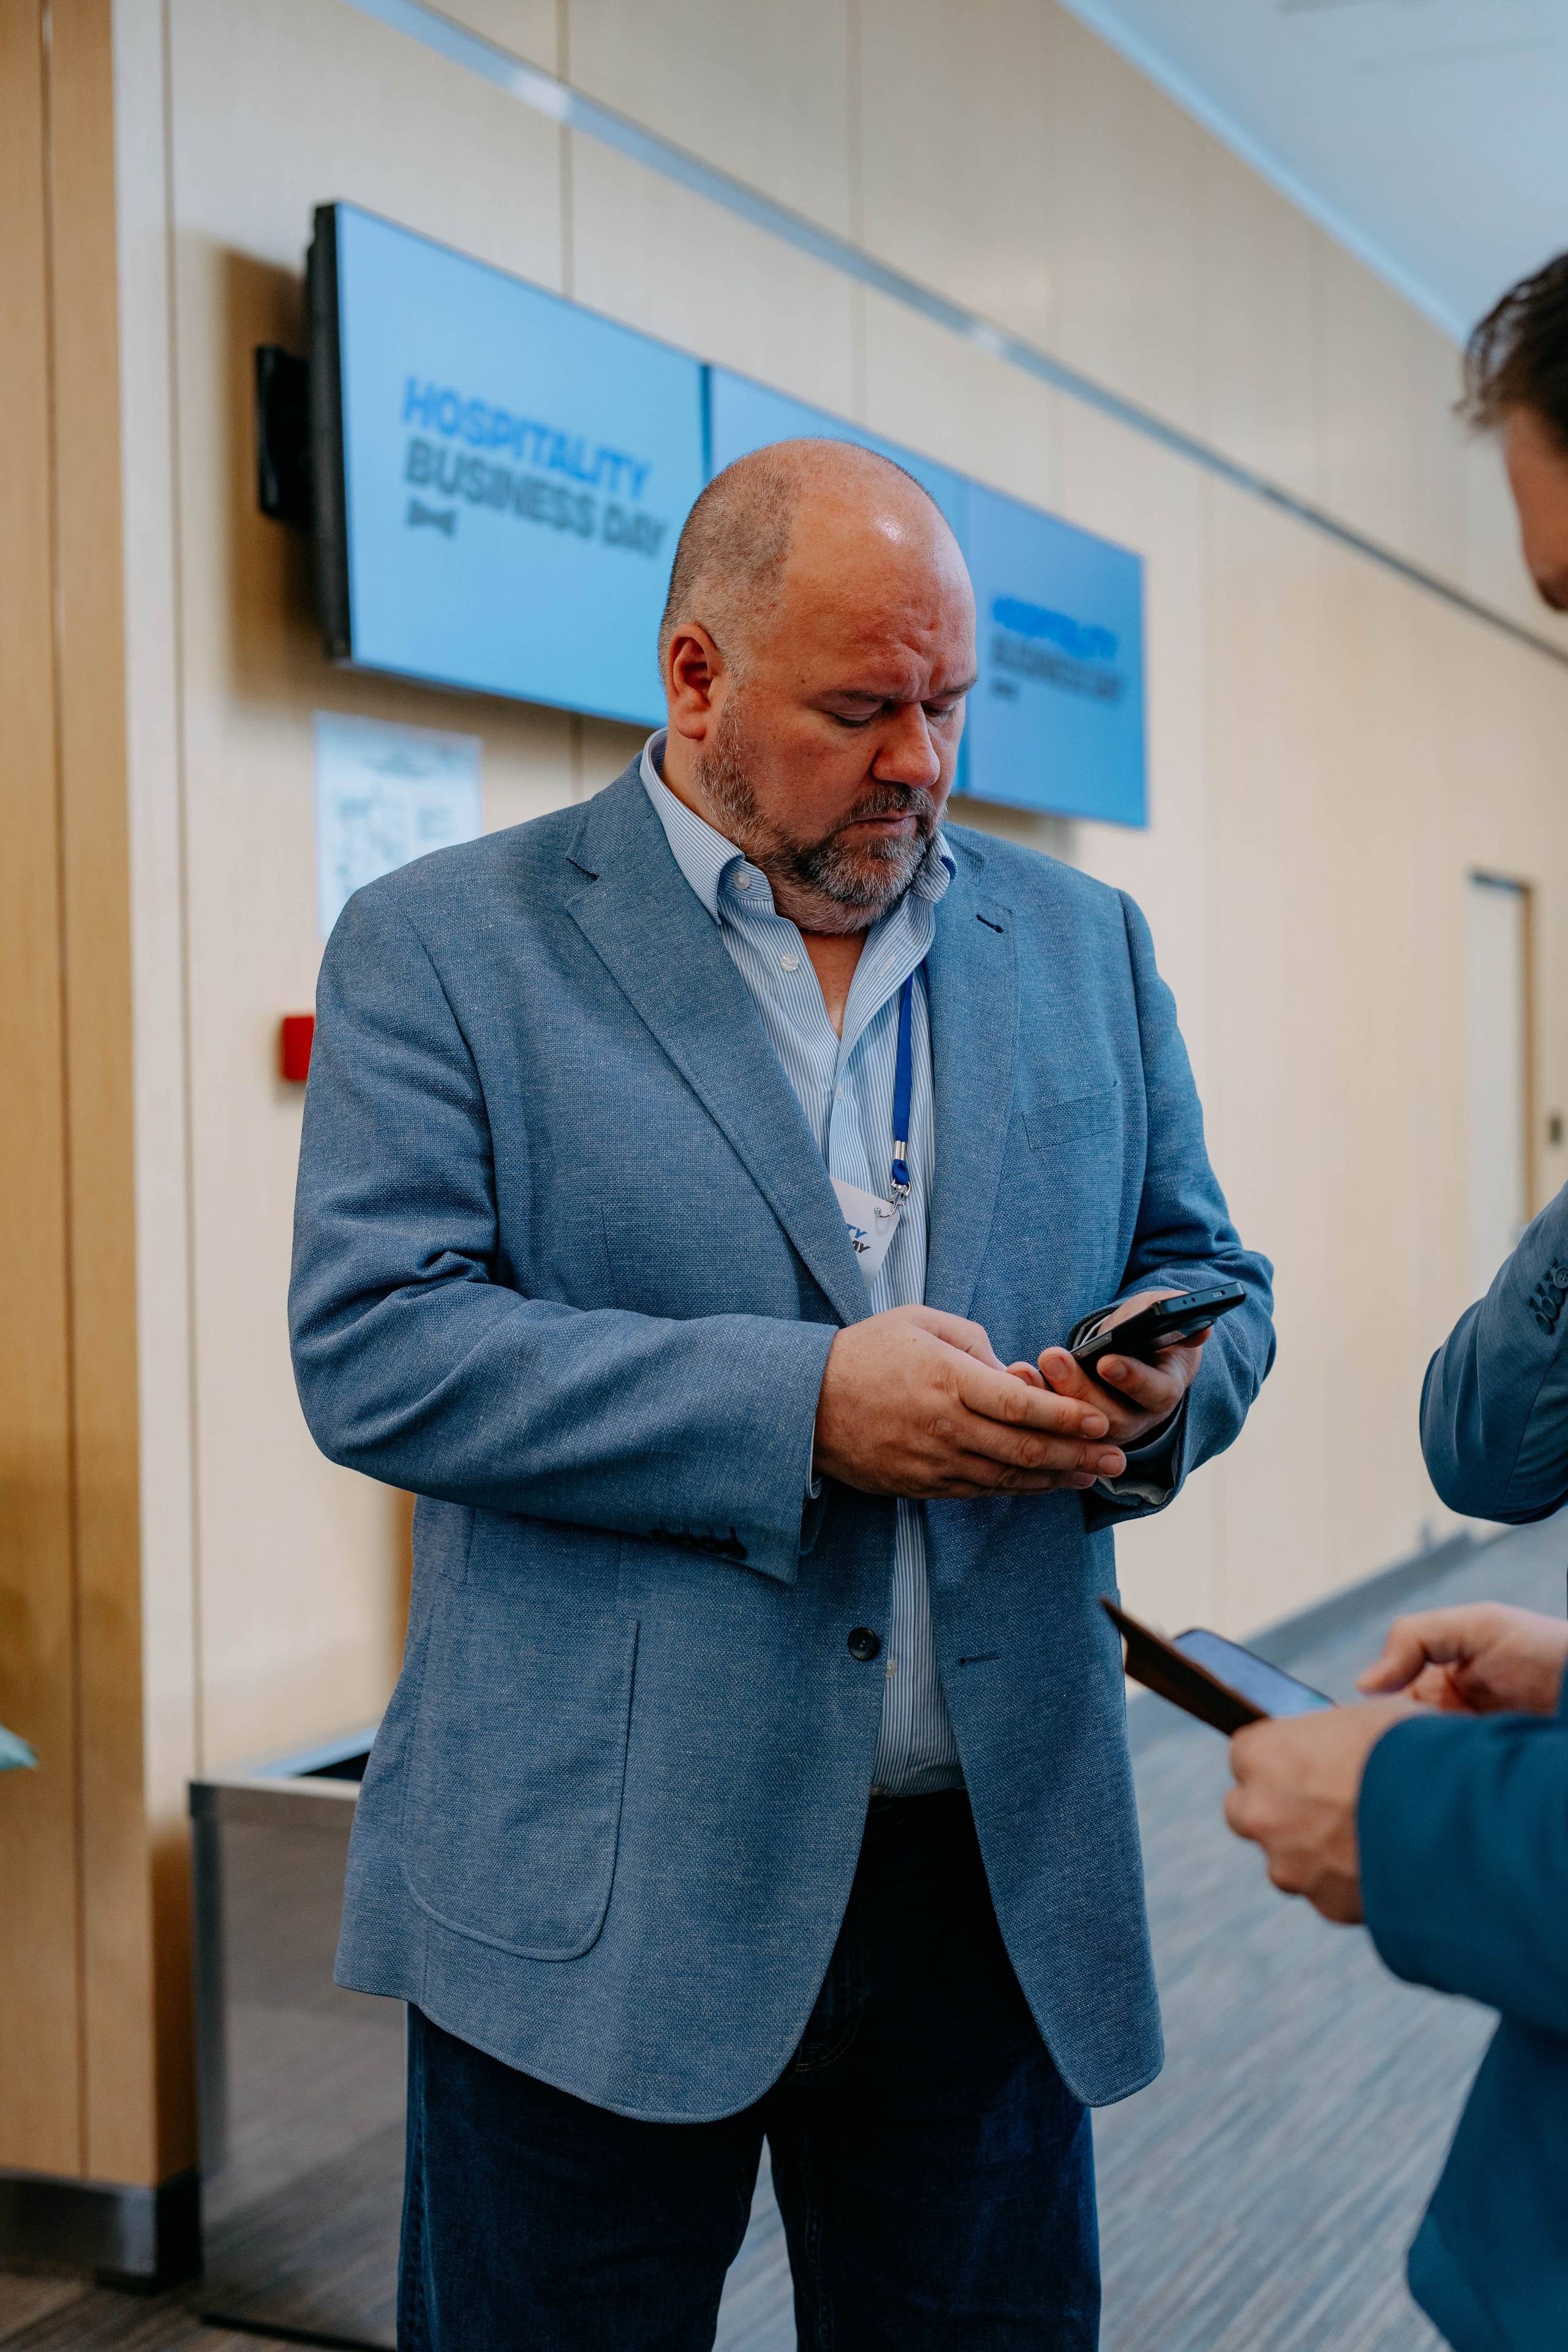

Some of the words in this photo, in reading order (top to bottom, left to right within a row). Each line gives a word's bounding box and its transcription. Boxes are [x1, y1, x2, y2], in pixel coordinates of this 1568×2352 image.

[403, 375, 651, 499] HOSPITALITY
[406, 437, 595, 539] BUSINESS
[603, 503, 668, 556] DAY
